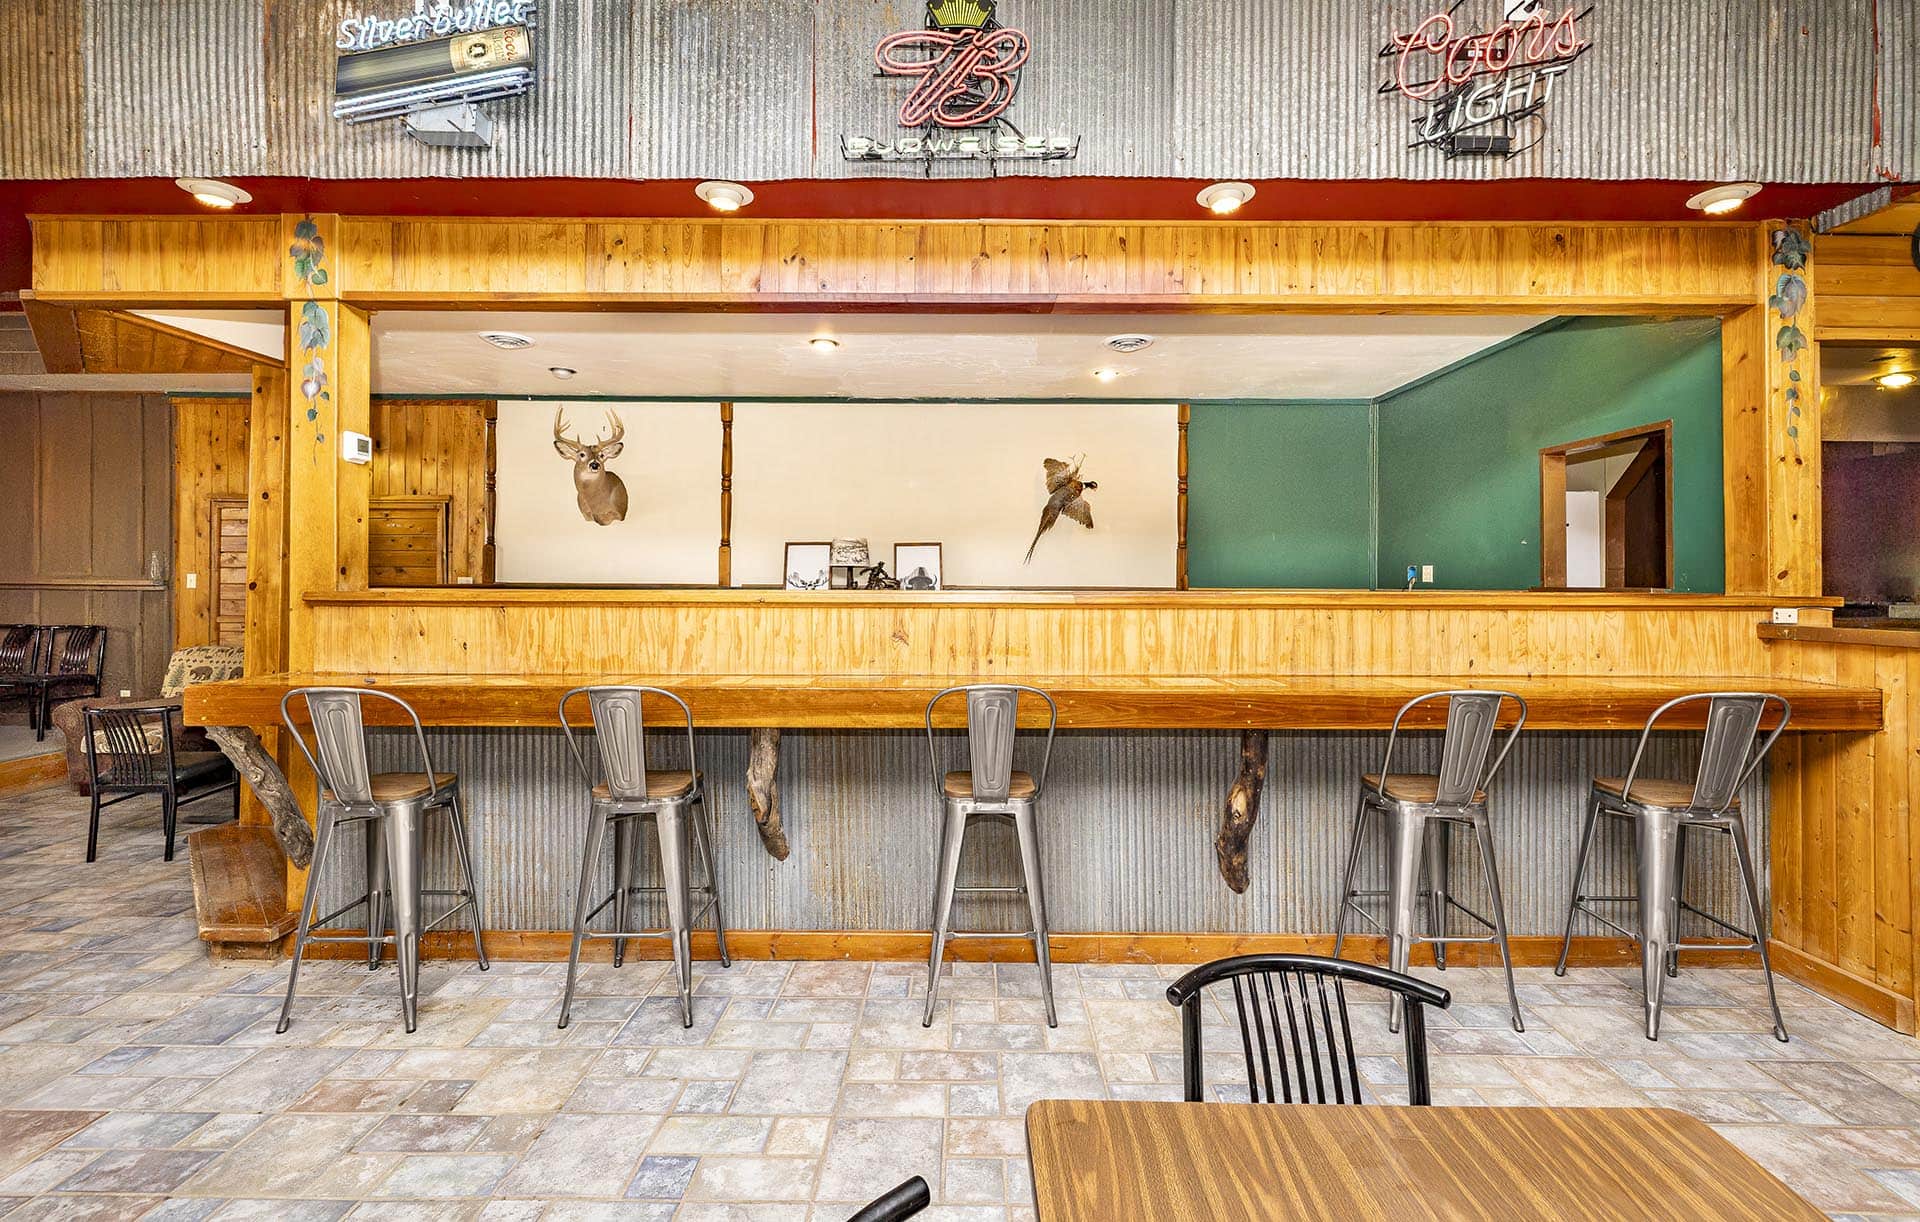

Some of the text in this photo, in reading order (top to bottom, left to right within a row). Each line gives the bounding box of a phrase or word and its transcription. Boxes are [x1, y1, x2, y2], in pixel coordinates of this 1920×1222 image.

[337, 15, 429, 49] Silver
[1394, 8, 1584, 97] Coors
[1423, 65, 1568, 141] LIGHT
